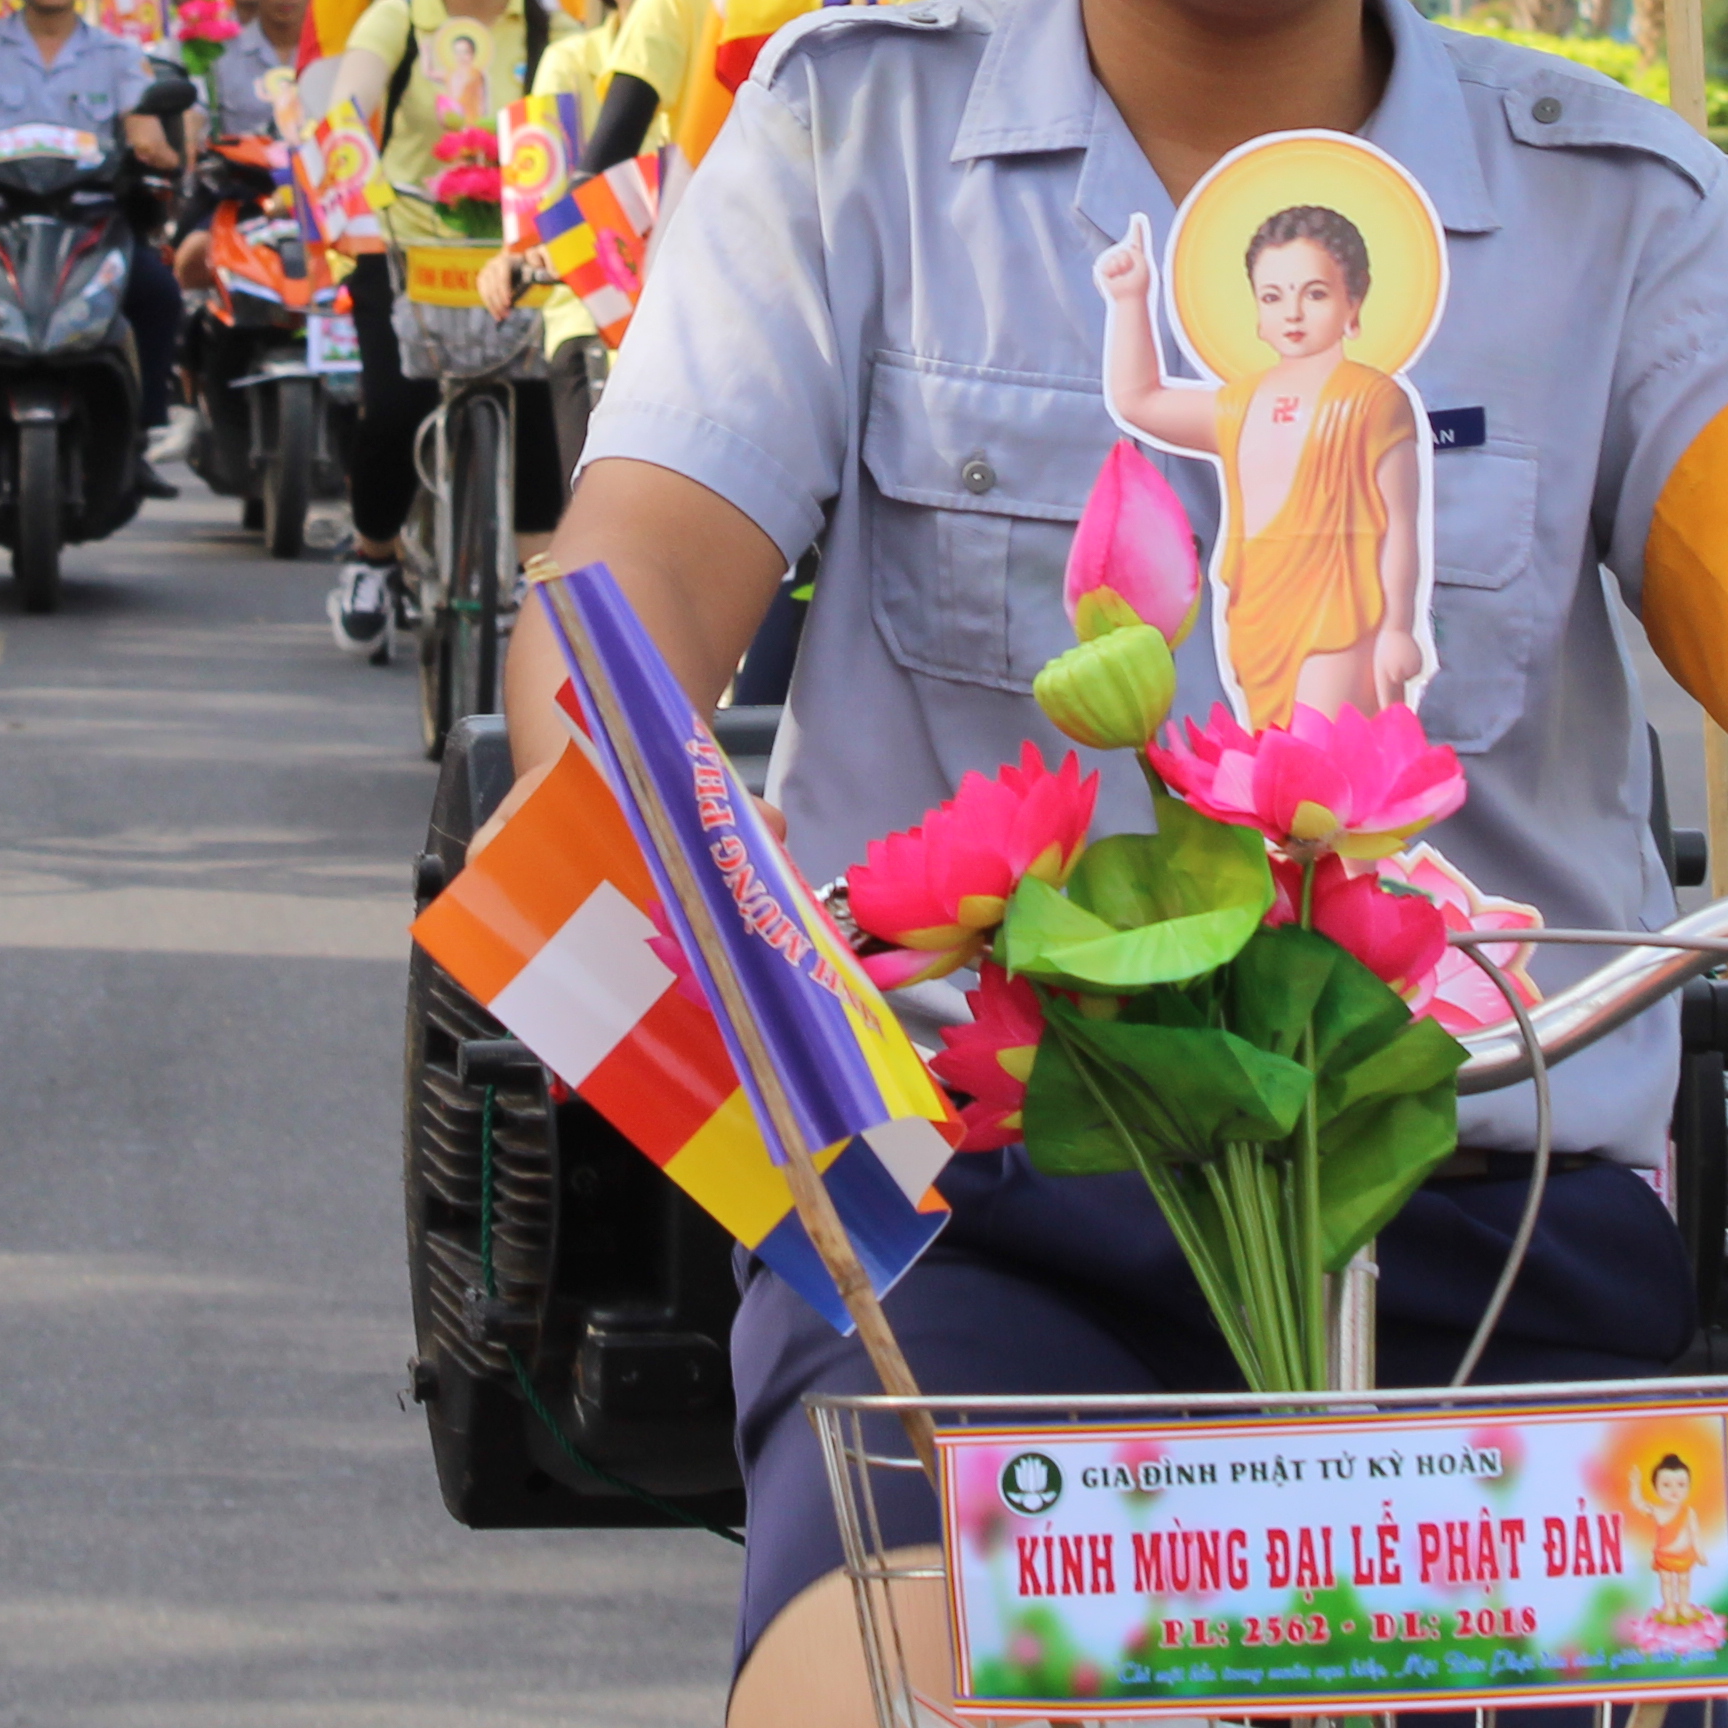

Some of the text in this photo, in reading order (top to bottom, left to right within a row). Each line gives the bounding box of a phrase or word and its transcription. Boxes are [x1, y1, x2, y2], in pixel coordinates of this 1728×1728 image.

[1082, 1465, 1132, 1488] GIA
[1141, 1458, 1217, 1487] ĐÌNH
[1230, 1455, 1306, 1487] PHẬT
[1417, 1447, 1499, 1476] HOÀN
[1016, 1520, 1117, 1597] KÍNH
[1265, 1526, 1334, 1605] ĐẠI
[1351, 1498, 1402, 1586] LỄ
[1417, 1505, 1526, 1596] PHẬT
[1543, 1496, 1624, 1578] ĐẢN
[1242, 1615, 1330, 1645] 2562
[1453, 1606, 1538, 1638] 2018
